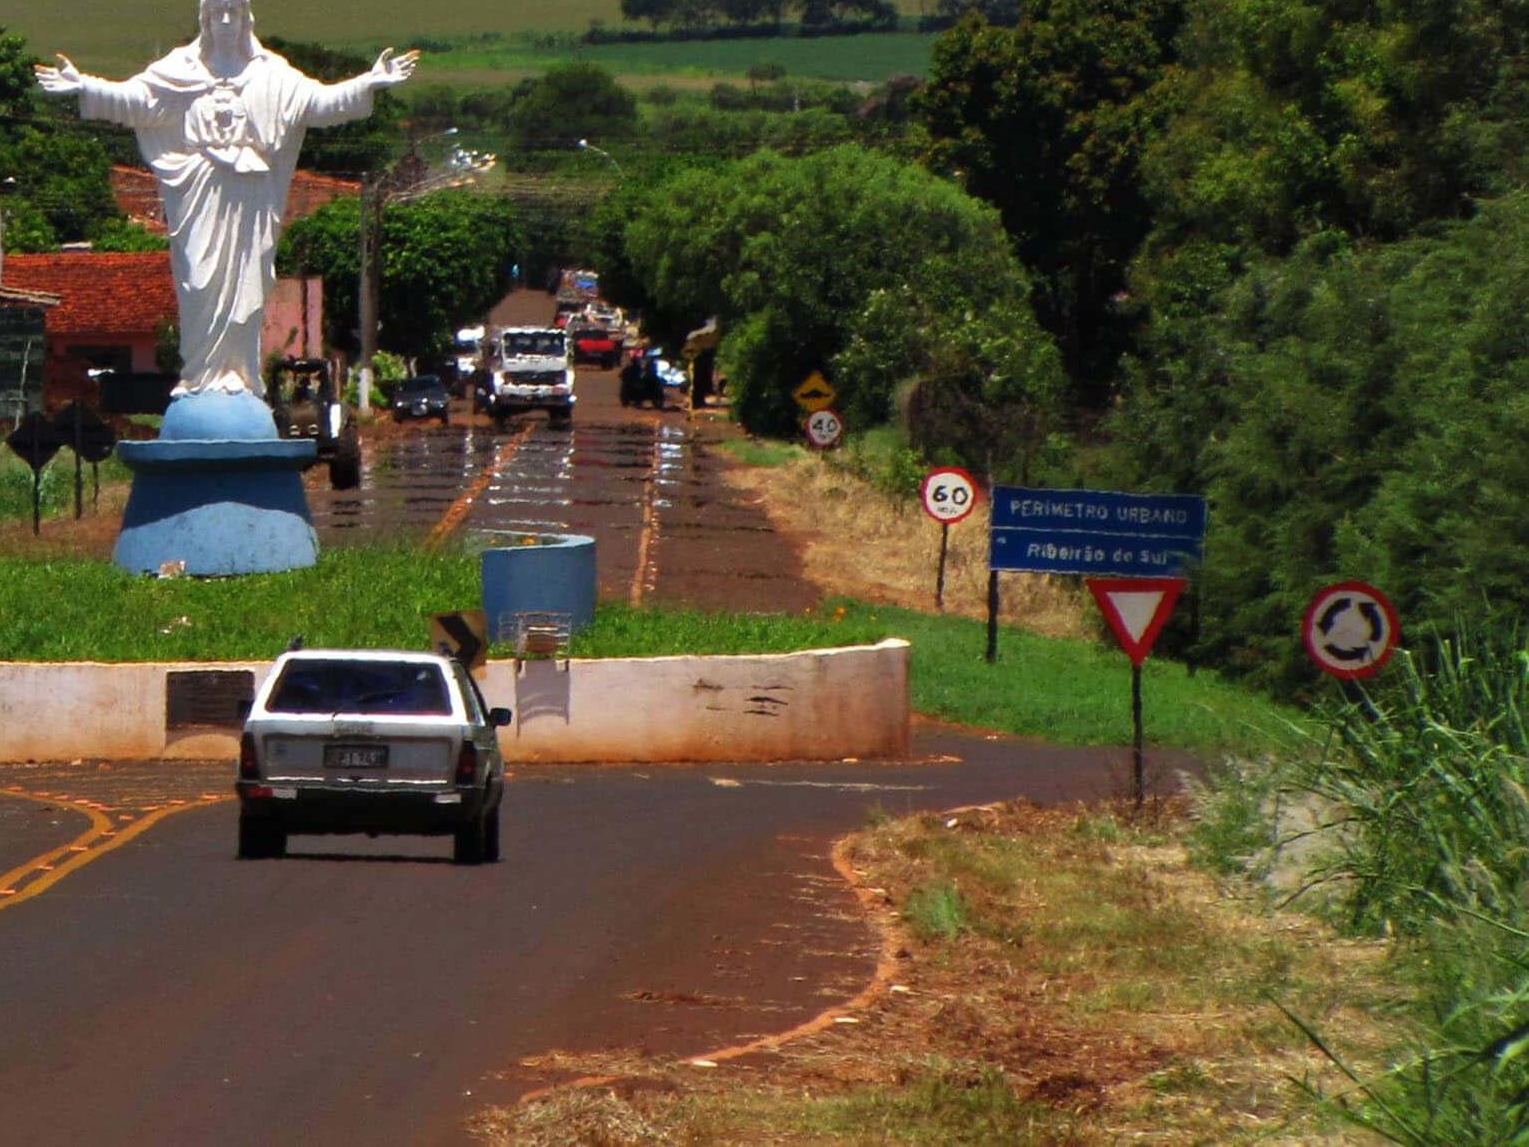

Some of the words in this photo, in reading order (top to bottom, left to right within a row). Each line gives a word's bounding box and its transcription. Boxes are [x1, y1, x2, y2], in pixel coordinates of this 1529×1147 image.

[812, 418, 838, 433] 40
[933, 485, 969, 505] 60
[1117, 506, 1187, 524] URBANO
[1026, 542, 1105, 562] Ribeirão
[1139, 549, 1167, 565] Sul
